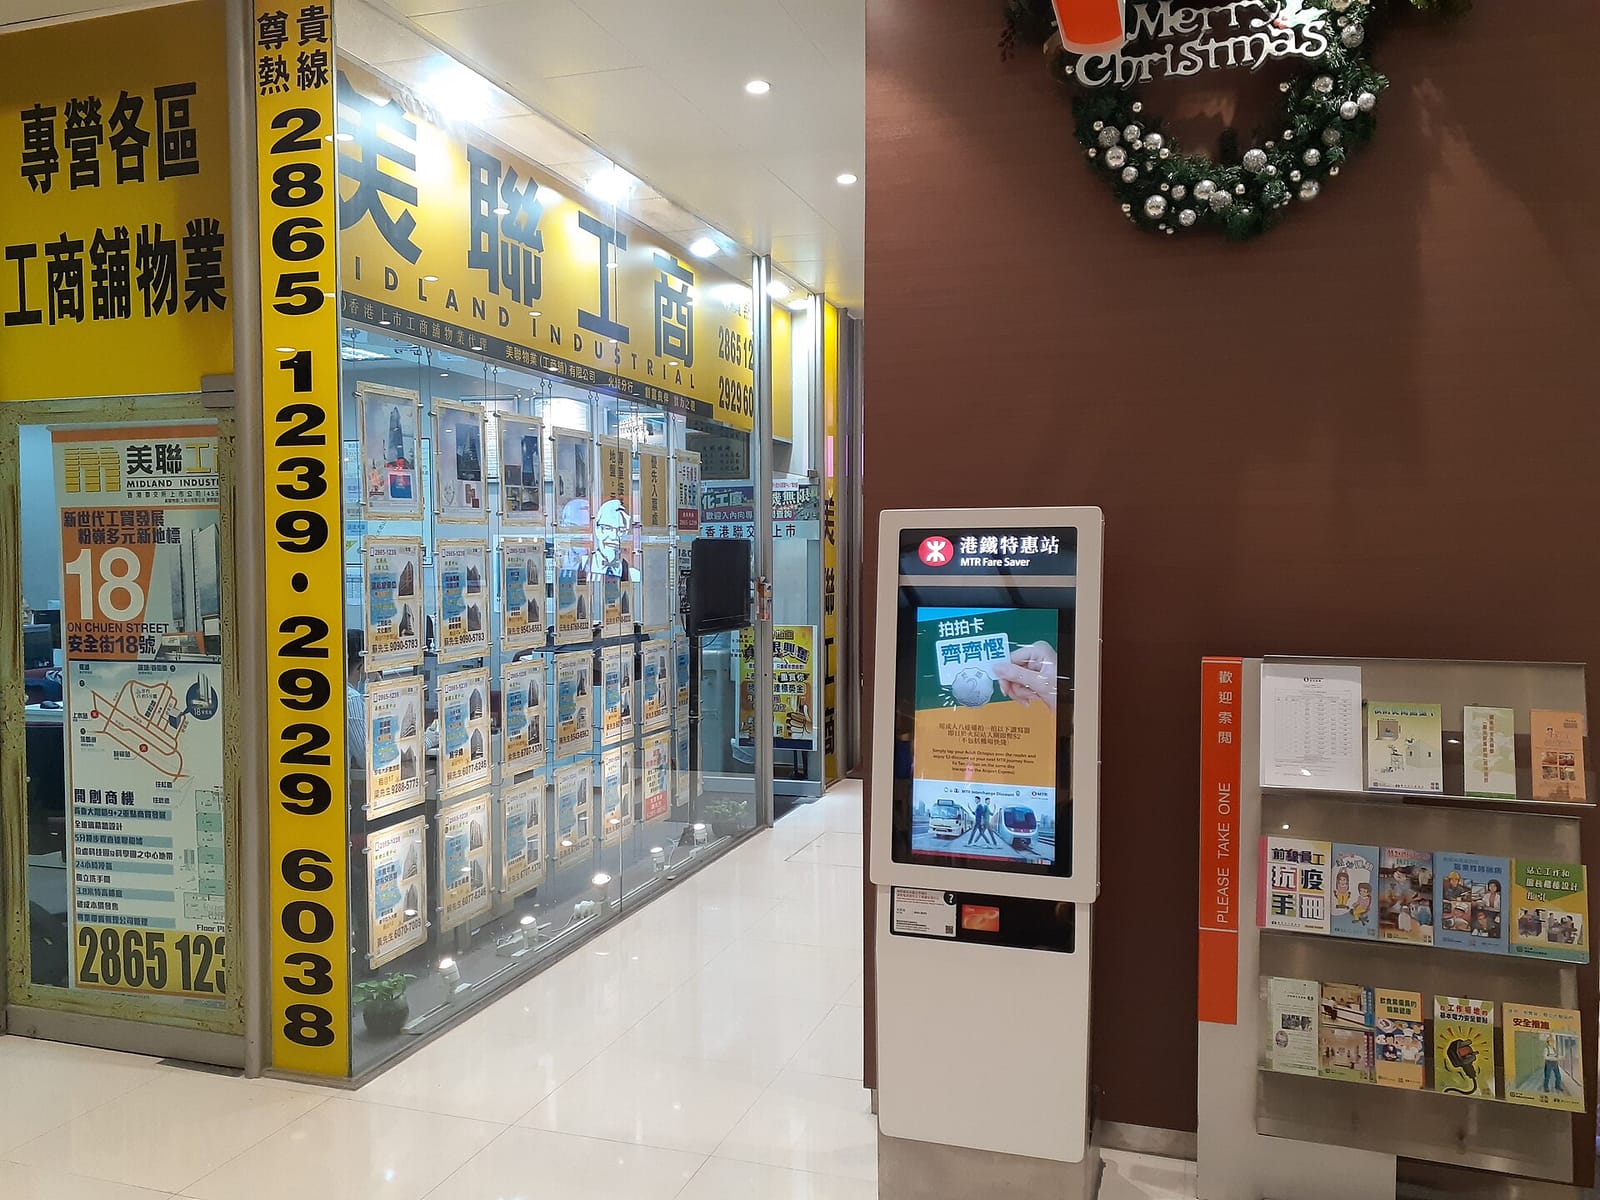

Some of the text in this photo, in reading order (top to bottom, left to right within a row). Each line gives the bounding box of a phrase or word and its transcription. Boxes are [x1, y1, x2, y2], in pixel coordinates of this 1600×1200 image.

[257, 5, 329, 50] 尊貴
[1127, 0, 1282, 41] Merry
[1075, 20, 1329, 87] Christmas
[258, 50, 329, 95] 熱線
[20, 82, 200, 194] 專營各區
[337, 70, 695, 368] 美聯工商
[4, 218, 227, 326] 工商舖物業
[355, 255, 695, 389] IDLAND INDUSTRIAL
[718, 325, 742, 361] 2865
[718, 375, 742, 411] 2929
[126, 443, 218, 475] 美聯工
[126, 479, 173, 488] MIDLAND
[64, 510, 164, 527] 新世代工貿發展
[78, 527, 181, 544] 粉嶺多元新地標
[960, 535, 1060, 555] 港鐵特惠站
[270, 107, 335, 1047] 2865 1239 2929 6038
[960, 557, 1030, 567] MTR Fare Saver
[65, 547, 145, 621] 18
[67, 622, 170, 634] ON CHUEN STREET
[938, 617, 985, 638] 拍拍卡
[68, 634, 156, 654] 安全街18號
[389, 639, 418, 652] 9090-5783
[940, 636, 1006, 666] 齊齊慳
[1217, 670, 1233, 744] 歡迎索閱
[74, 789, 135, 806] 開創商機
[1216, 782, 1231, 924] PLEASE TAKE ONE
[1272, 866, 1325, 891] 抗疫
[1272, 893, 1325, 920] 手冊
[196, 923, 216, 933] Floor
[79, 927, 168, 989] 2865
[1512, 1017, 1550, 1030] 安全措施
